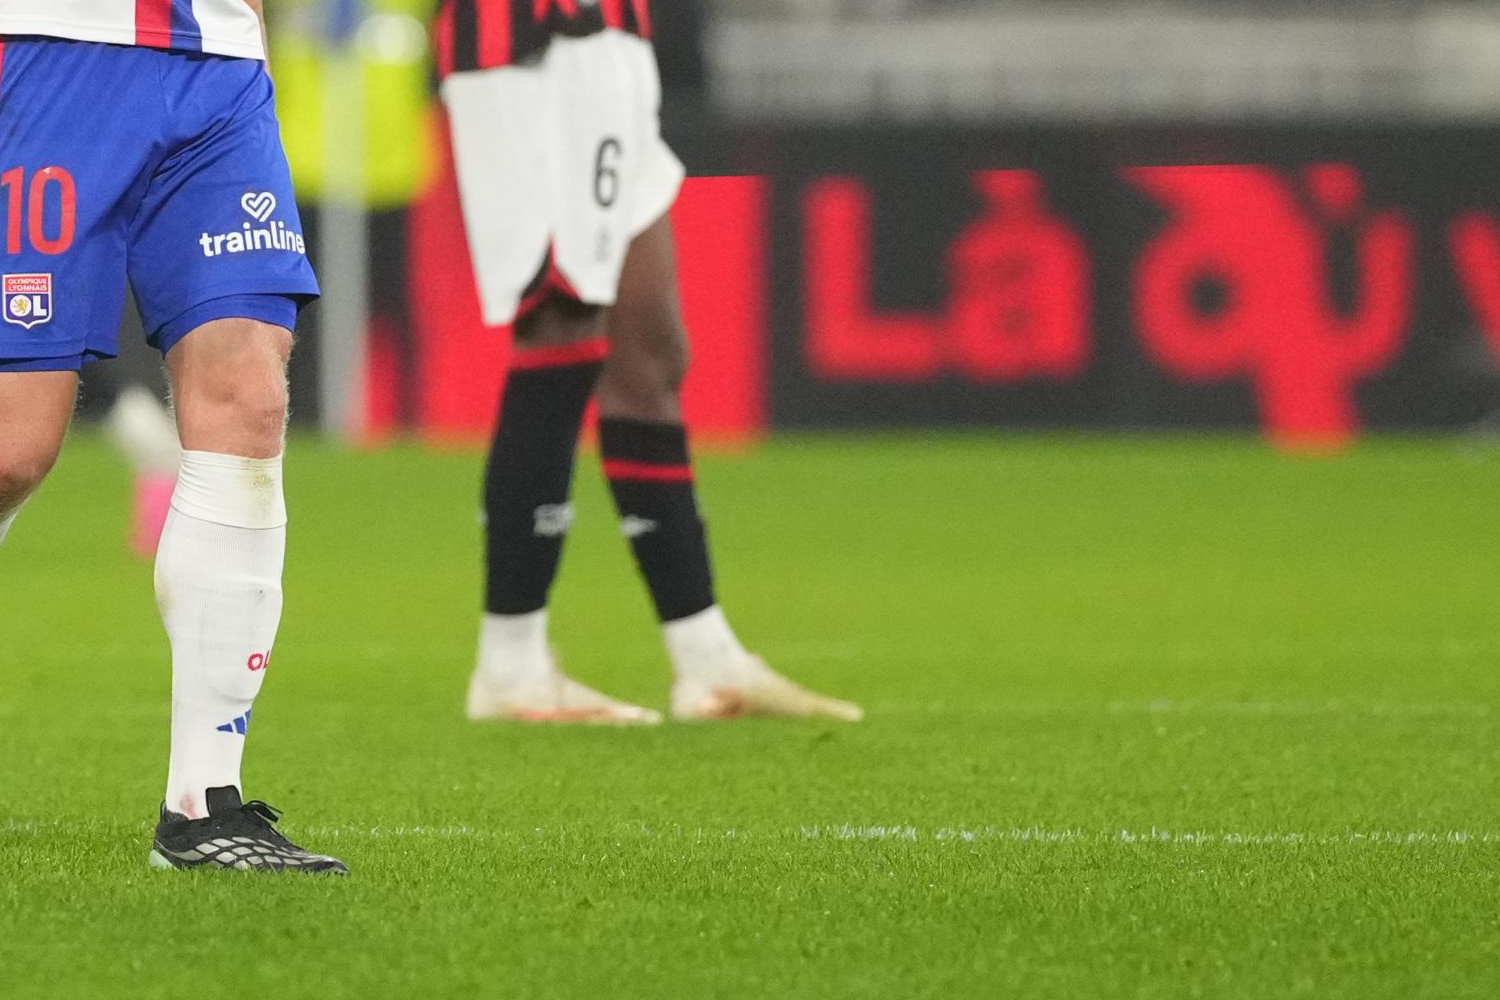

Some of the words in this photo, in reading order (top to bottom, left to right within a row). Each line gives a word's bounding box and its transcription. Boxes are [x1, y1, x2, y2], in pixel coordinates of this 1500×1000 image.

[593, 136, 622, 209] 6
[1, 166, 76, 255] 10
[199, 221, 305, 257] trainline
[8, 284, 48, 292] LYONNAIS
[10, 295, 47, 317] OL
